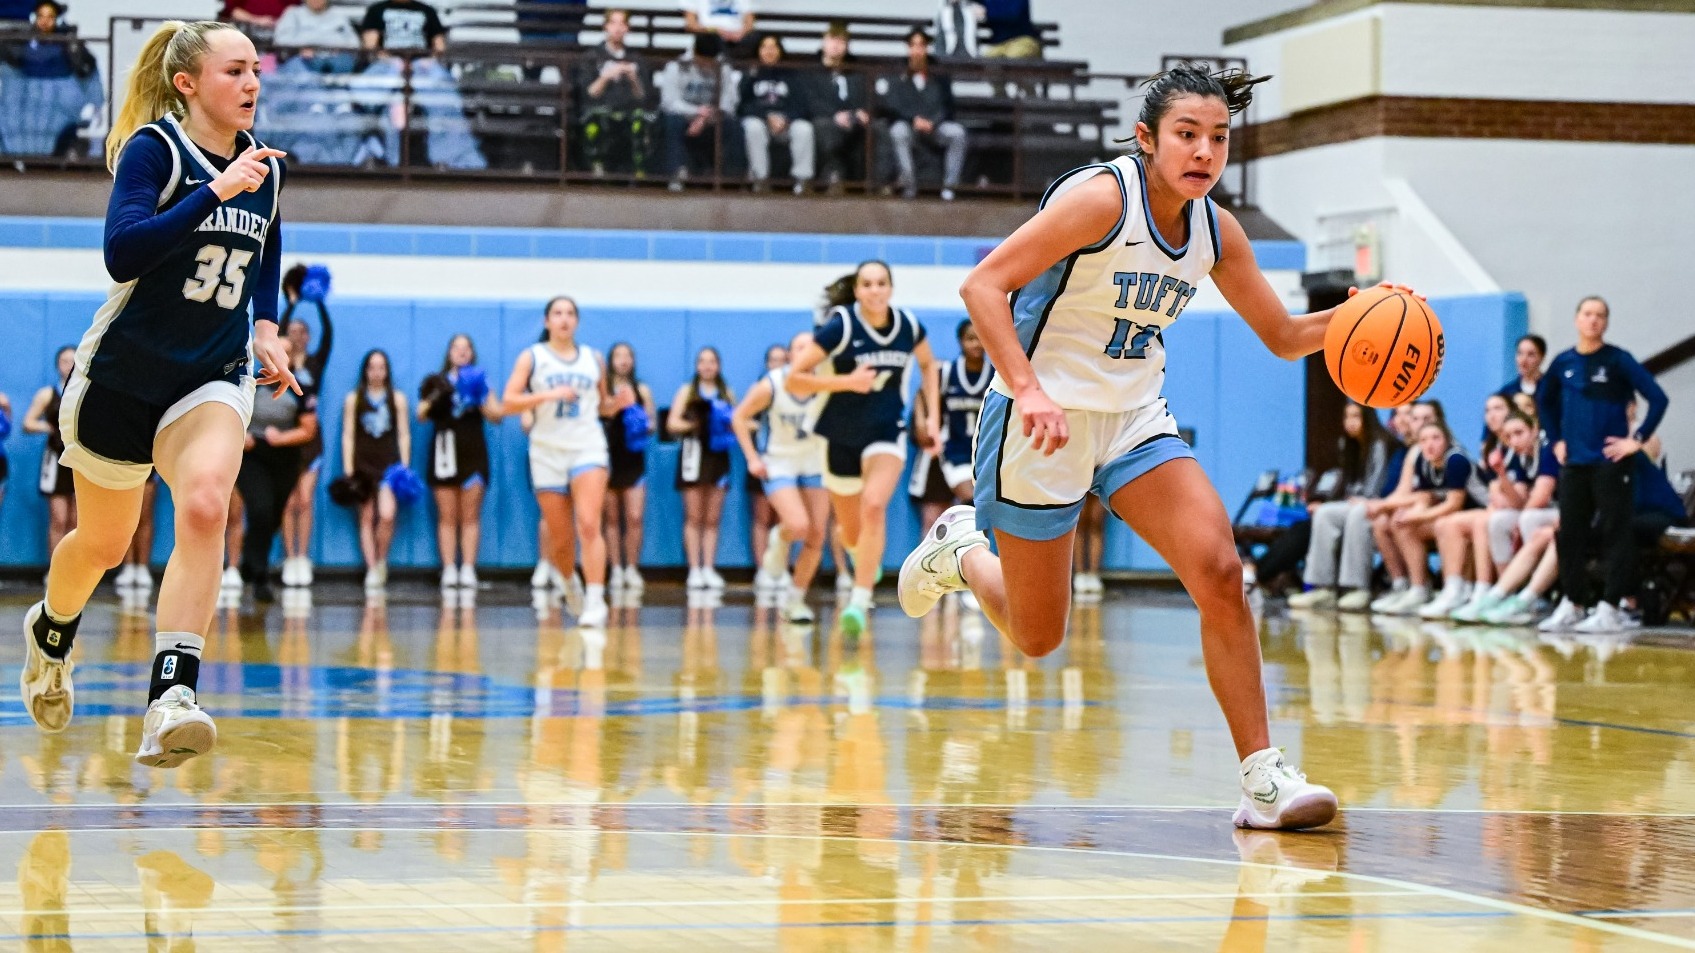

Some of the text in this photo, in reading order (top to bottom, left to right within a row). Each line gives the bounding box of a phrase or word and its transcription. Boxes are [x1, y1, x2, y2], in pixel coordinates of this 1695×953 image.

[194, 206, 269, 243] RANDEI
[182, 244, 254, 310] 35
[1392, 343, 1421, 392] EVO
